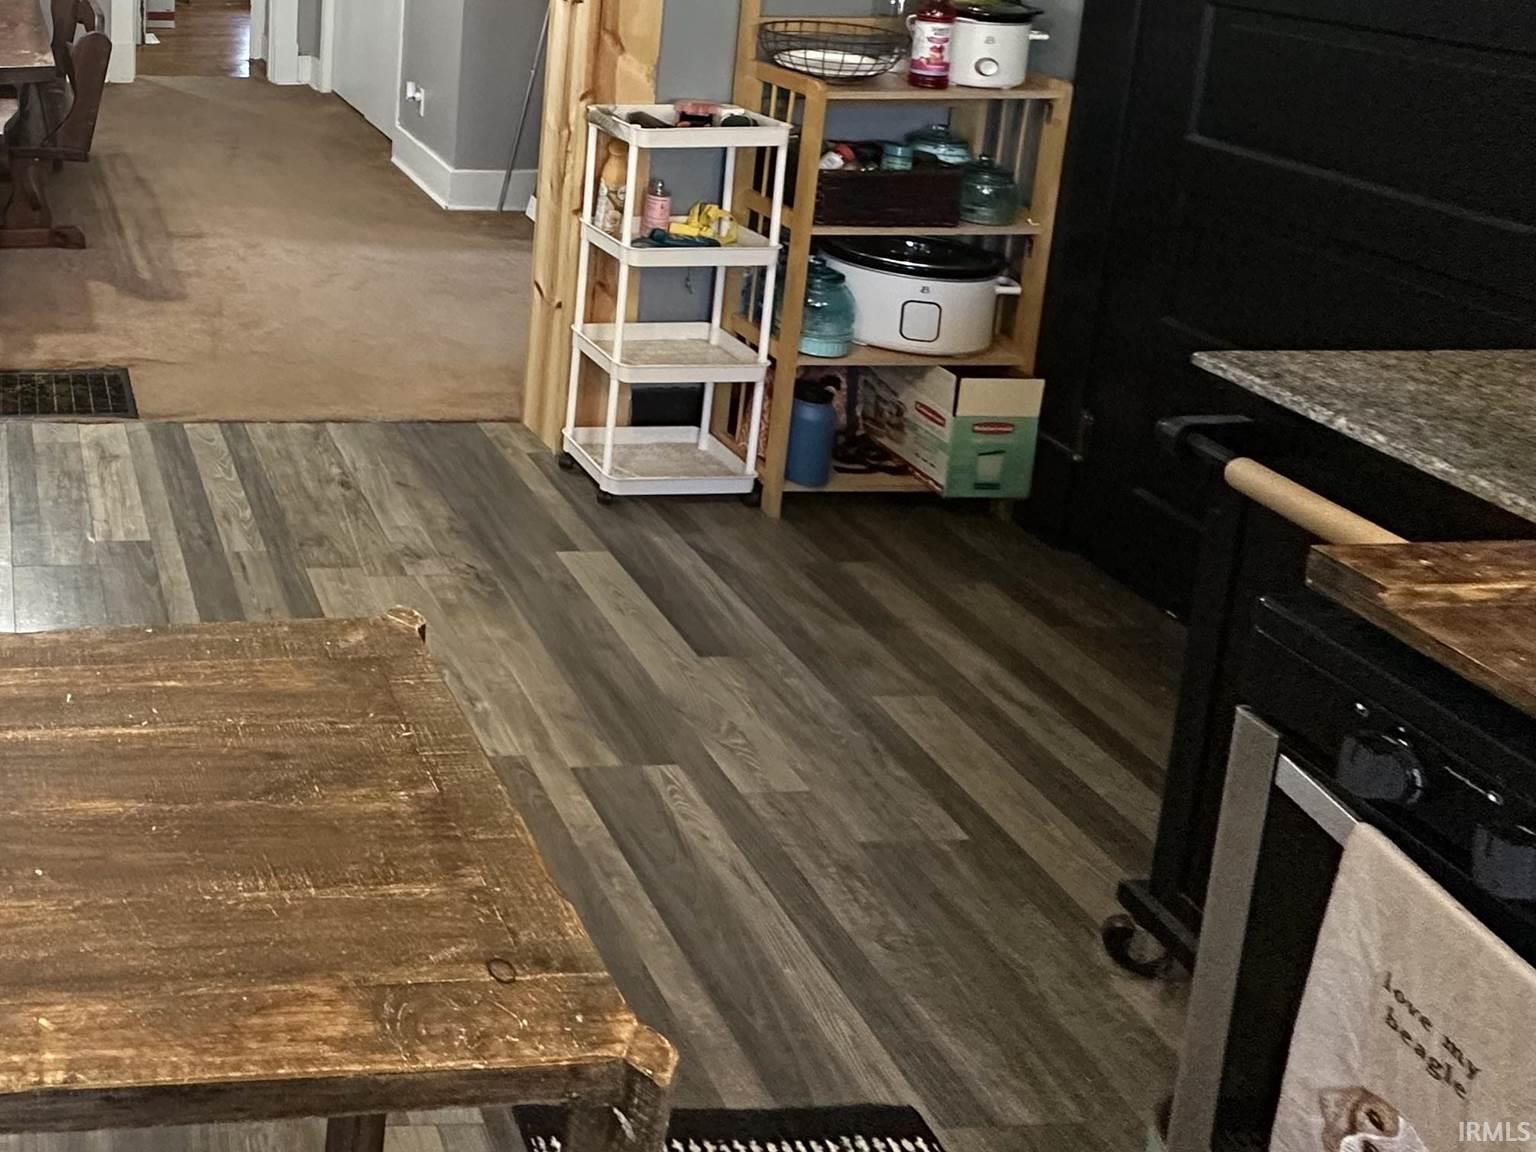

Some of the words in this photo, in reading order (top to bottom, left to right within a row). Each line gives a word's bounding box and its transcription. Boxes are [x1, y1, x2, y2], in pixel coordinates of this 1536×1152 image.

[1382, 970, 1433, 1033] love
[1441, 1033, 1482, 1081] my
[1384, 1004, 1468, 1100] beagle
